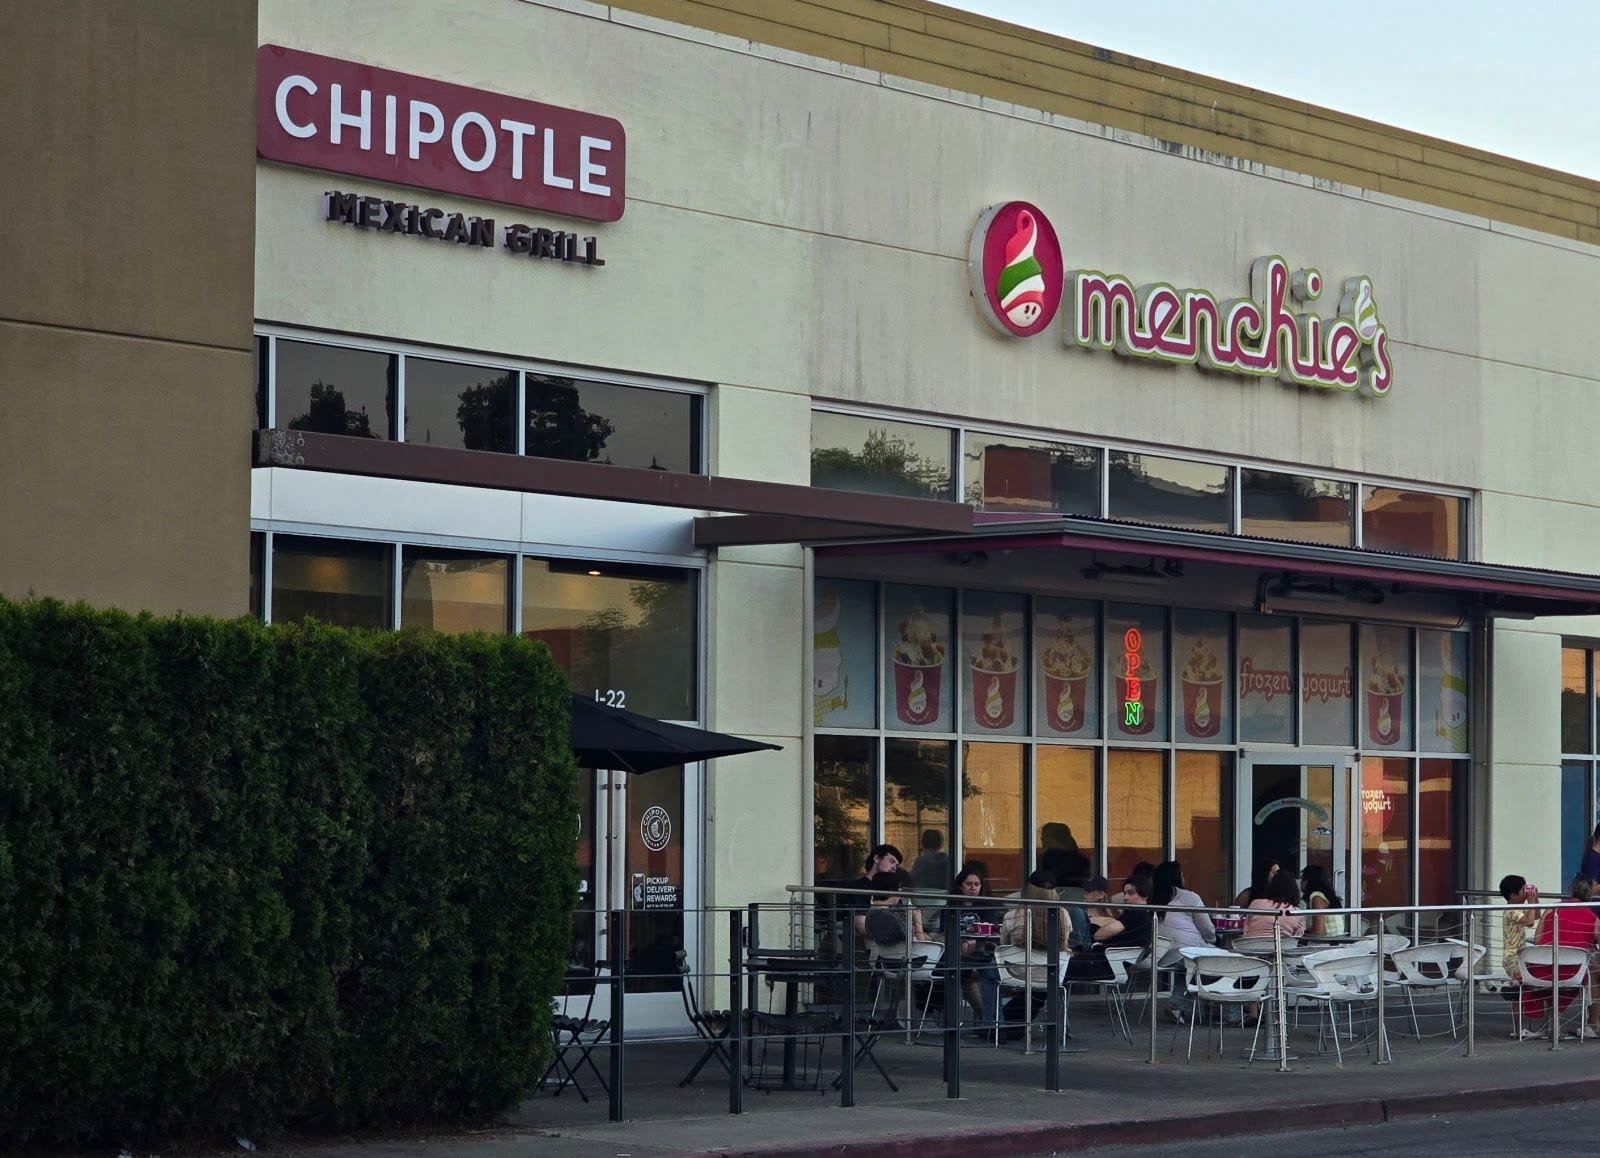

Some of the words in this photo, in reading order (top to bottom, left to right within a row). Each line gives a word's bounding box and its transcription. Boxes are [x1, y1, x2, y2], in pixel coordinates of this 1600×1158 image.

[275, 75, 612, 197] CHIPOTLE
[322, 190, 495, 248] MEXICAN
[504, 223, 605, 266] GRILL
[1075, 256, 1393, 397] menchie's
[1124, 628, 1142, 725] OPEN
[1240, 659, 1292, 699] frozen
[1303, 667, 1351, 701] yogurt
[1361, 789, 1385, 802] rozen
[1363, 796, 1391, 814] yogurt
[643, 809, 668, 826] CHIPOTLE
[646, 877, 669, 885] PICKUP
[646, 885, 676, 894] DELIVERY
[646, 894, 677, 902] REWARDS
